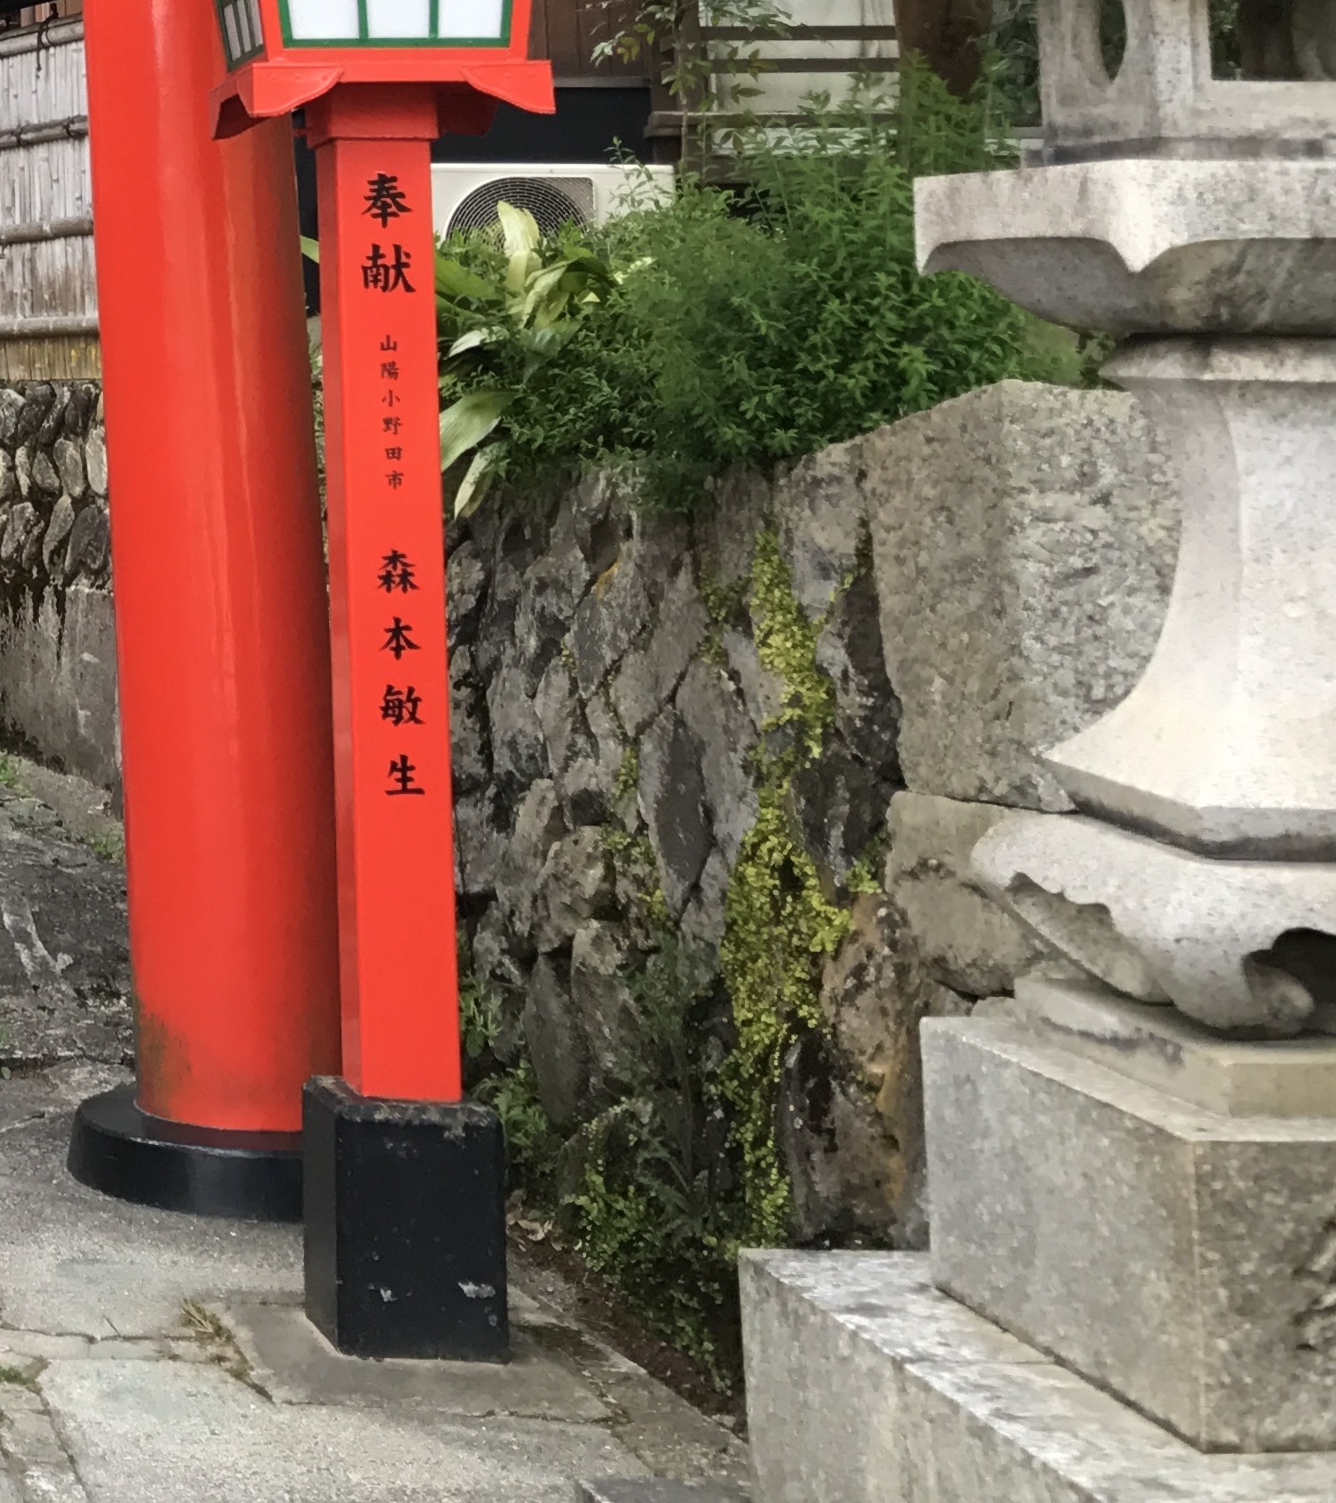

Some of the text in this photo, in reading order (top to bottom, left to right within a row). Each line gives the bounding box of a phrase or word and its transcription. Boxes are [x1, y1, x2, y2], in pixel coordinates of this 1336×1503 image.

[360, 172, 426, 796] 奉献 山陽小野田市 森本敏生
